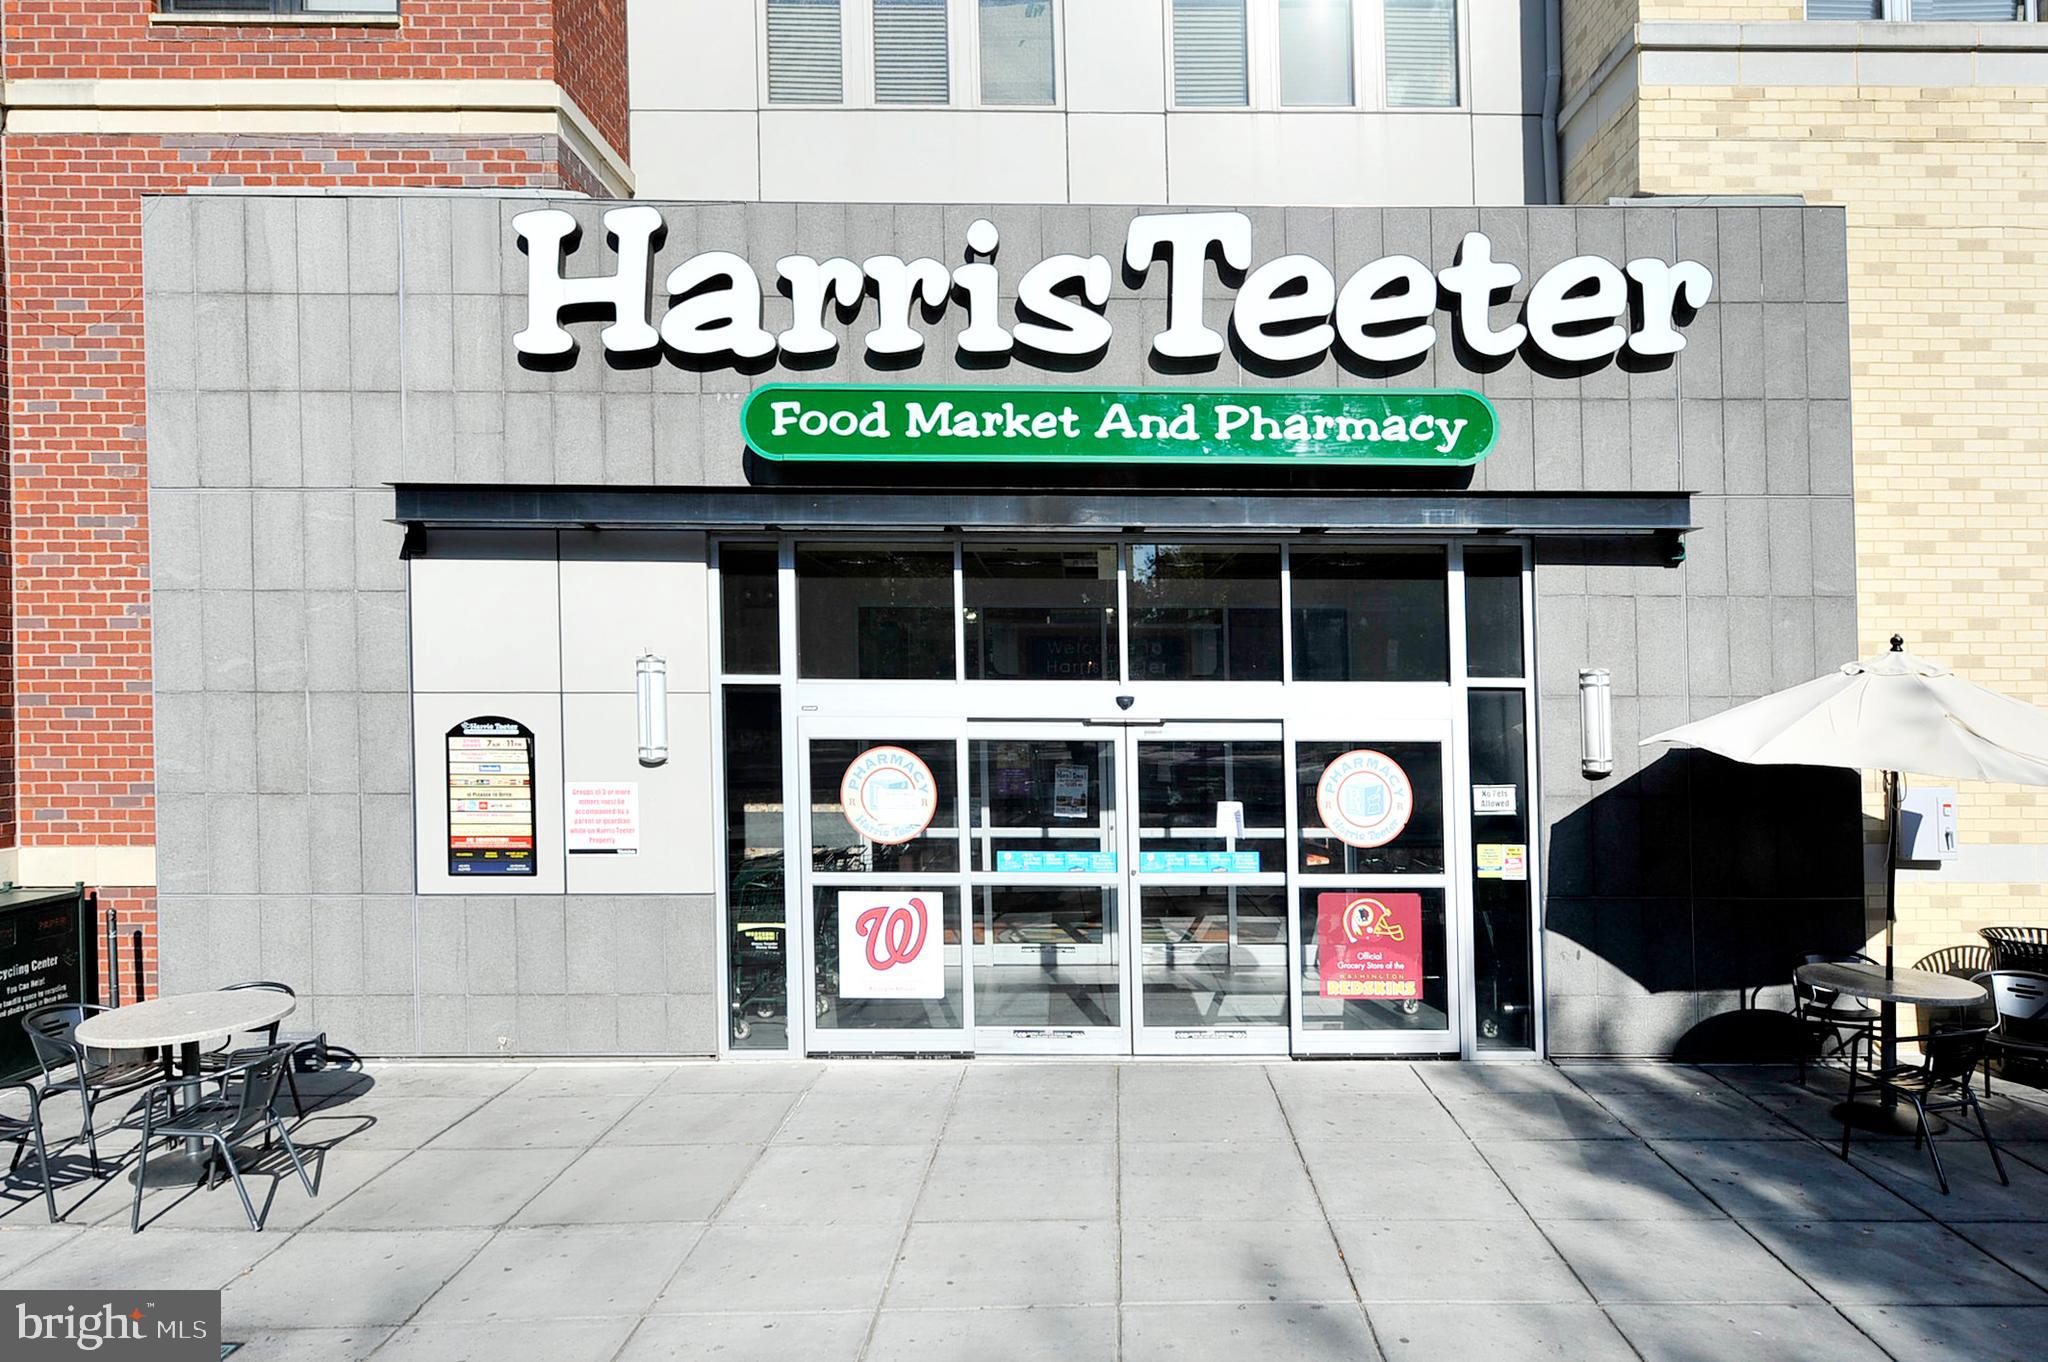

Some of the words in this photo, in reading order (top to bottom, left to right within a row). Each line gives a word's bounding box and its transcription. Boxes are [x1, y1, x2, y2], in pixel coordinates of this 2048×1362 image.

[512, 206, 1113, 360] Harris
[1126, 212, 1713, 361] Teeter
[770, 400, 891, 438] Food
[904, 402, 1081, 439] Market
[1093, 402, 1198, 441] And
[1214, 403, 1469, 453] Pharmacy
[848, 753, 929, 795] PHARMACY
[1325, 757, 1405, 797] PHARMACY
[855, 898, 928, 971] W
[31, 956, 59, 972] Center
[1337, 961, 1365, 971] Grocery
[1366, 961, 1384, 969] Store
[1385, 961, 1393, 969] of
[1394, 961, 1404, 970] the
[1357, 952, 1383, 960] Official
[1327, 980, 1416, 995] REDSKINS
